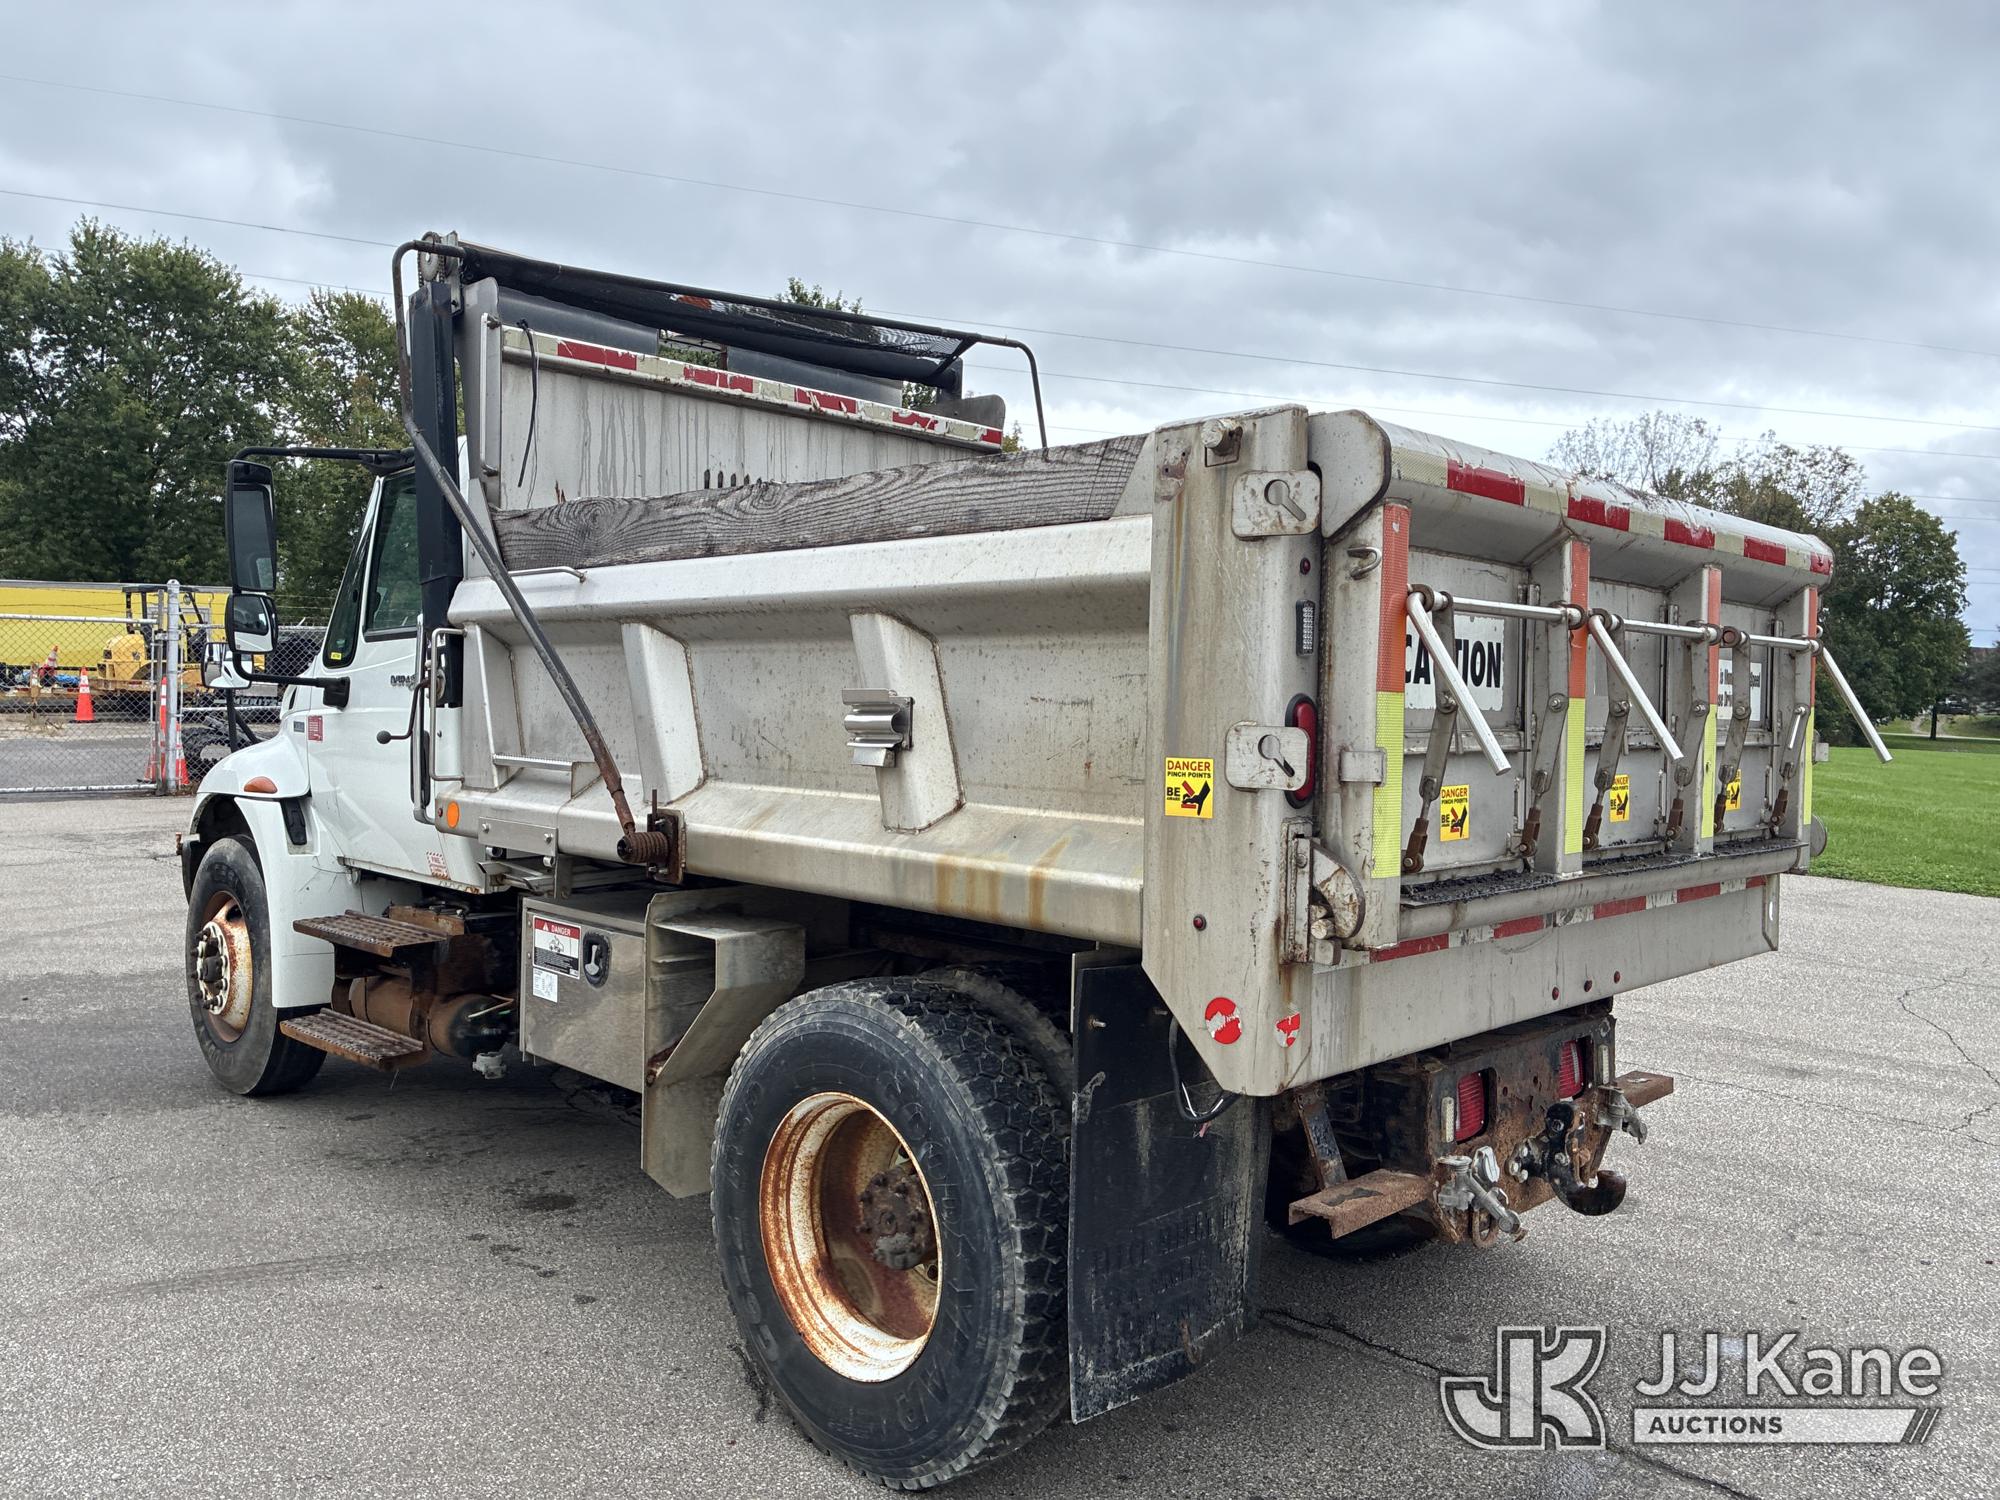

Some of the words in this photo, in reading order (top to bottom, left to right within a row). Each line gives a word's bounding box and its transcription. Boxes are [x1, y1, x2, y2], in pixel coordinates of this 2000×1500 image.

[1405, 634, 1501, 688] AION
[1167, 760, 1211, 771] DANGER
[1166, 786, 1181, 796] BE
[1441, 787, 1468, 798] DANGER
[1441, 814, 1450, 823] BE
[550, 924, 571, 937] DANGER
